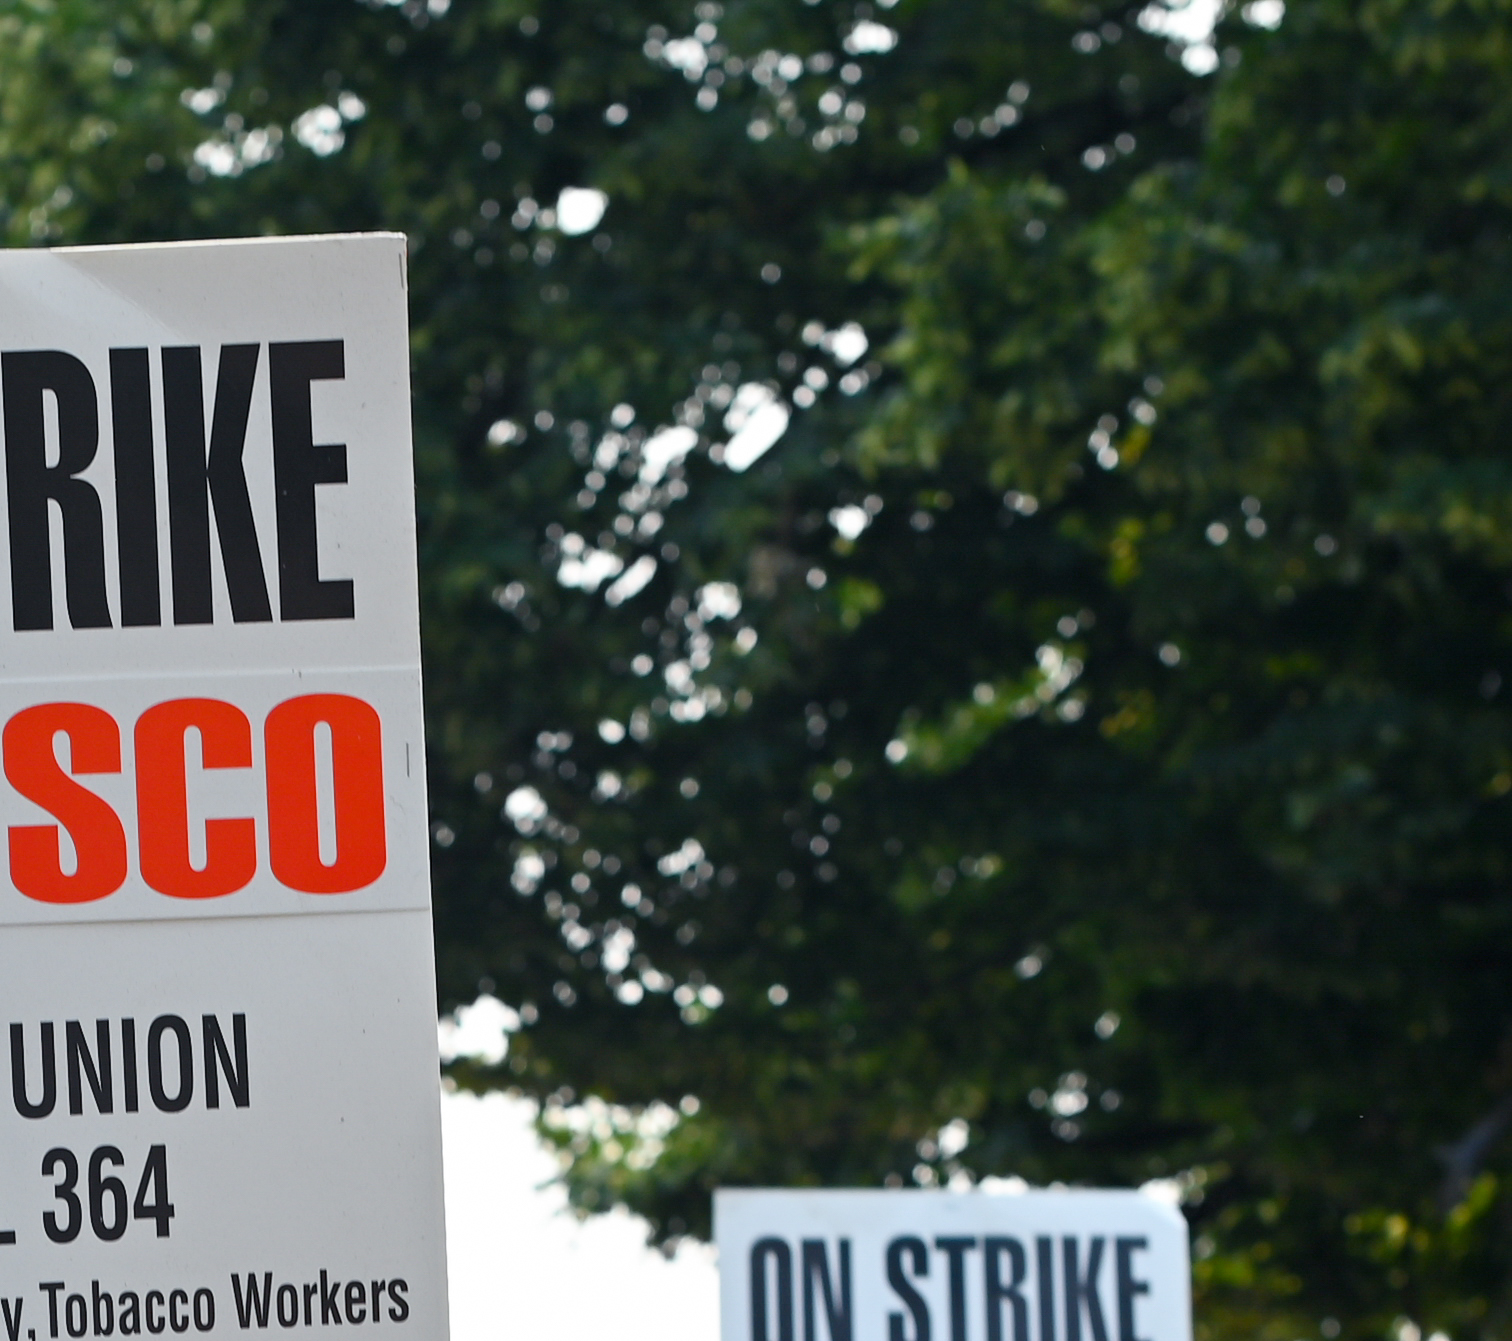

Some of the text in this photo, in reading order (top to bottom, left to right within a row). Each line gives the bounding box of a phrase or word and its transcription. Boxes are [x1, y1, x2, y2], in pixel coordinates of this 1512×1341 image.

[9, 1012, 251, 1120] UNION
[41, 1144, 176, 1244] 364
[230, 1268, 410, 1330] Workers
